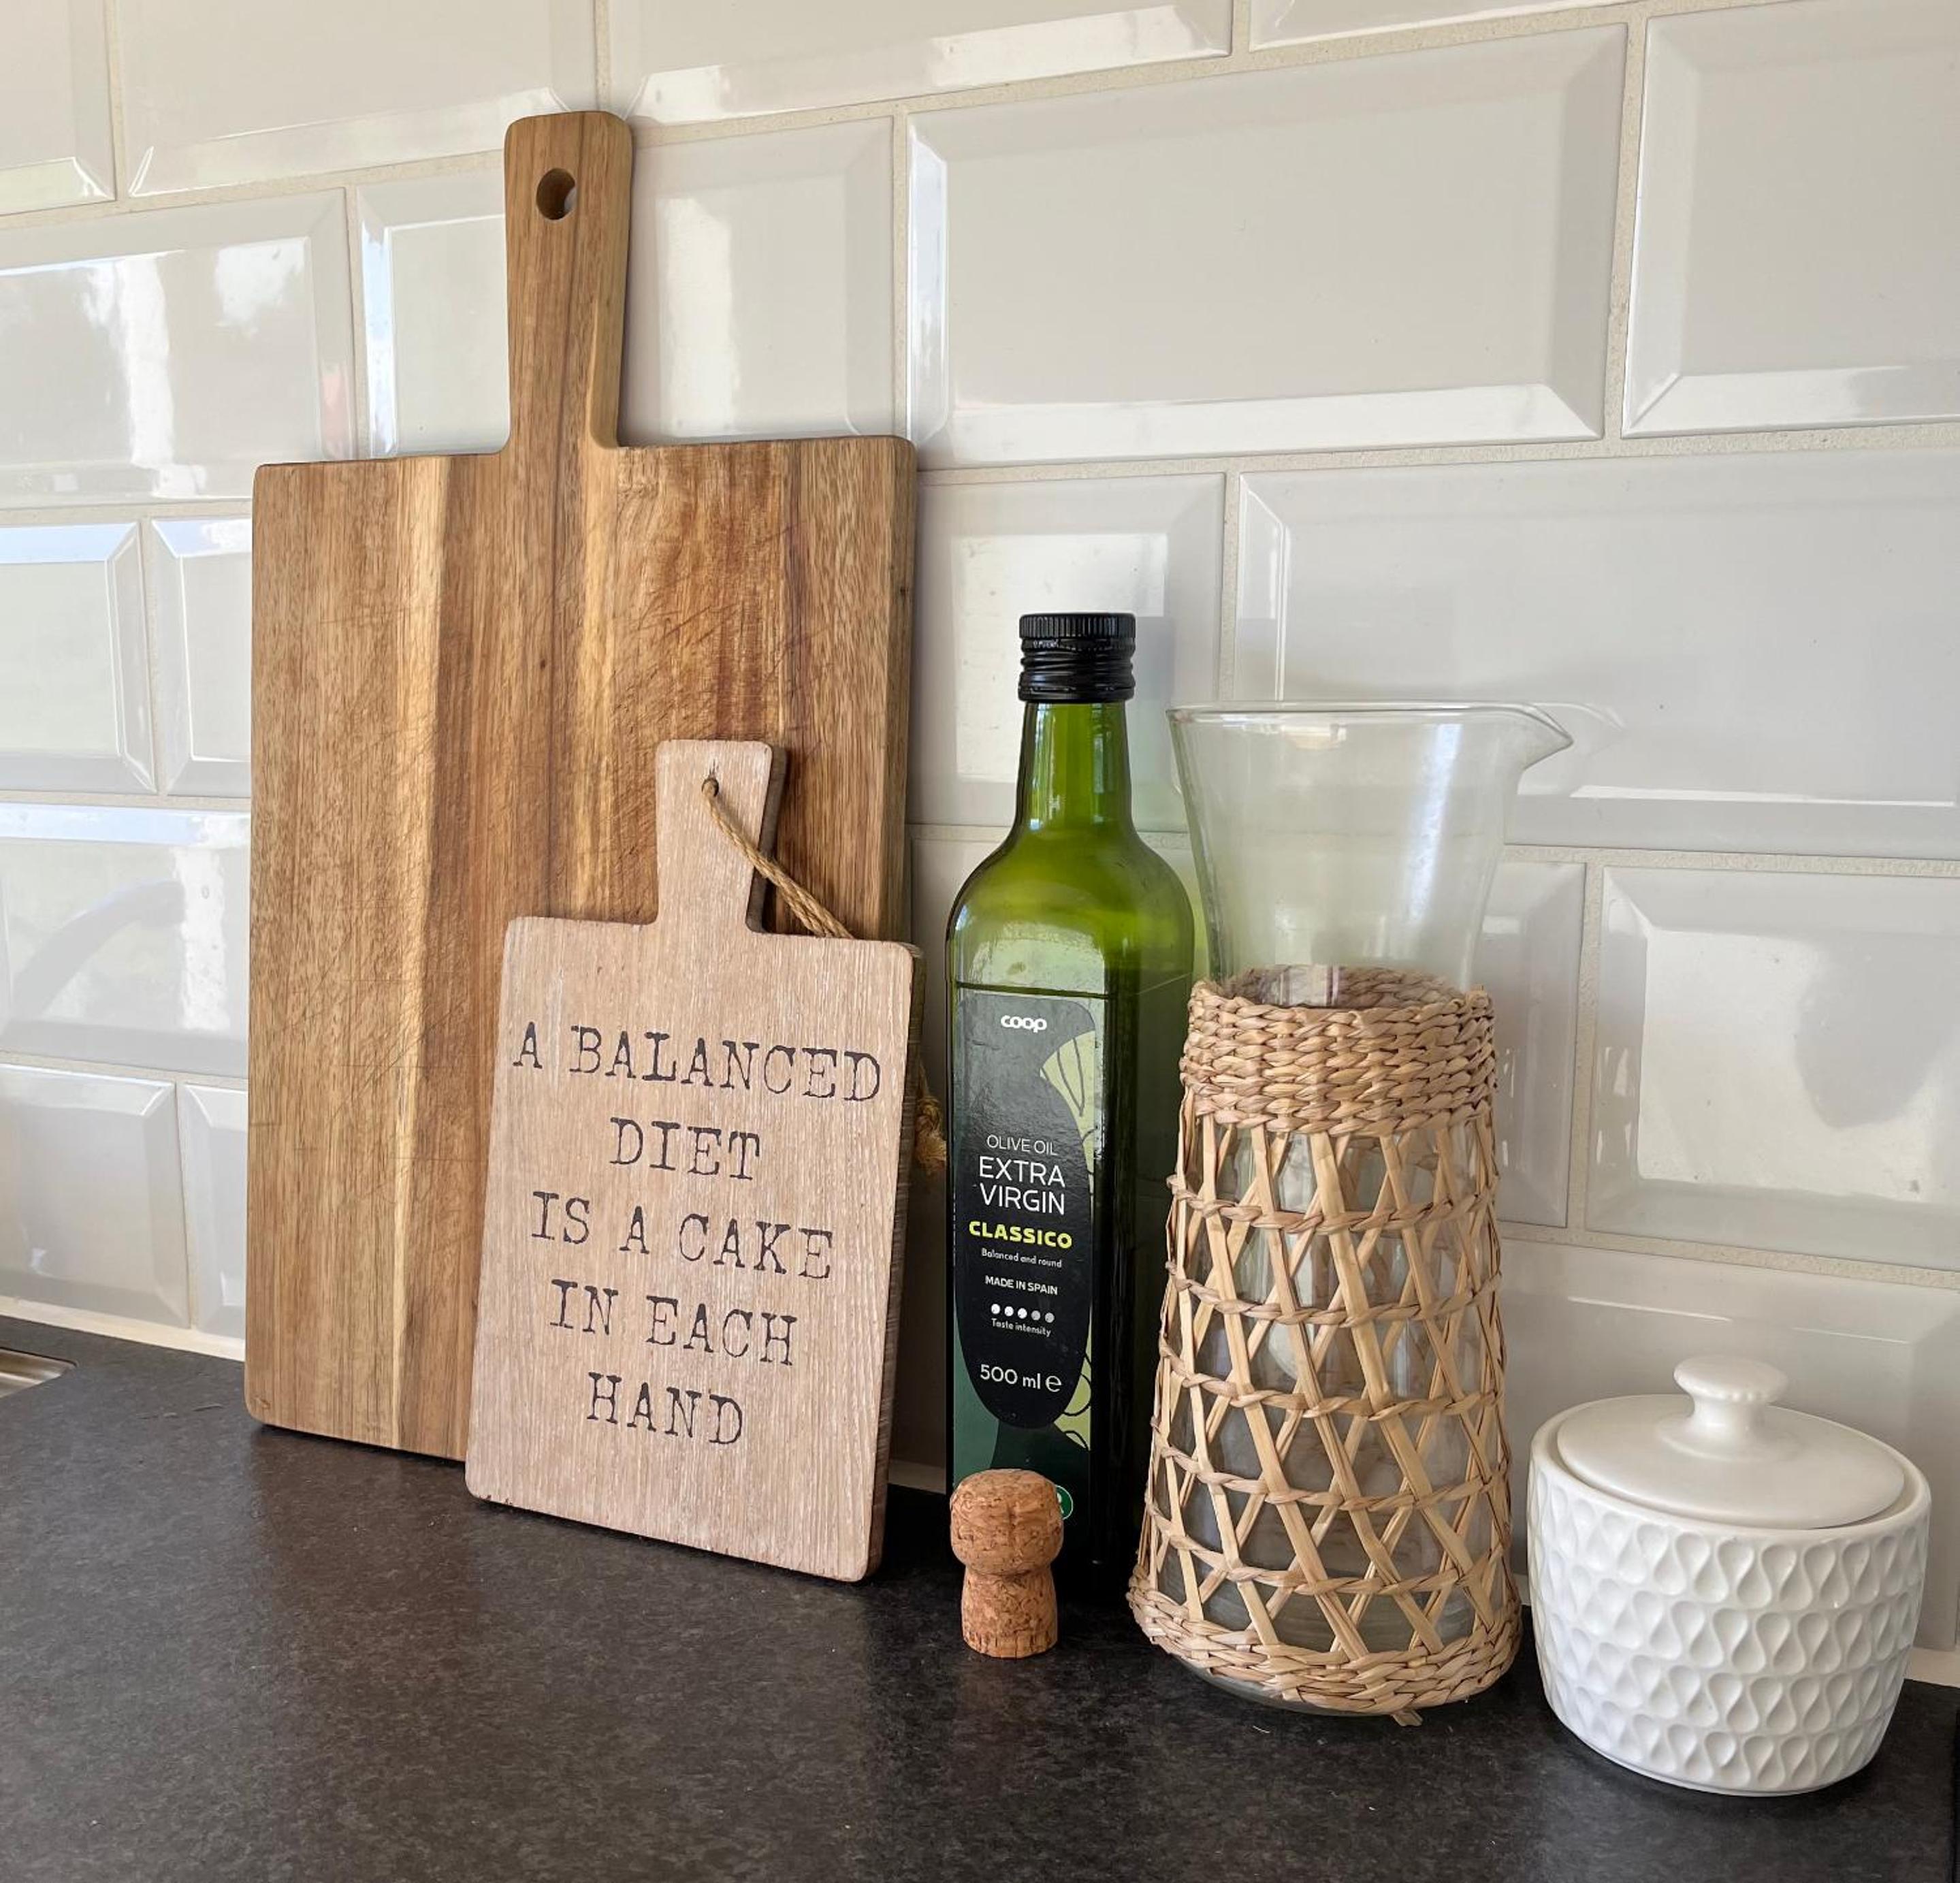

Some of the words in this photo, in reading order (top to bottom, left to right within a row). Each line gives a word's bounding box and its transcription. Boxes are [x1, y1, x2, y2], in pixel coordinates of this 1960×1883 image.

[1000, 1015, 1048, 1033] coop
[512, 1021, 543, 1069] A
[569, 1025, 881, 1101] BALANCED
[609, 1116, 760, 1180] DIET
[986, 1134, 1031, 1152] OLIVE
[1034, 1140, 1058, 1156] OIL
[979, 1156, 1066, 1187] EXTRA
[979, 1182, 1065, 1215] VIRGIN
[532, 1191, 590, 1244] IS
[619, 1205, 650, 1255] A
[678, 1213, 833, 1280] CAKE
[969, 1221, 1073, 1249] CLASSICO
[981, 1247, 1019, 1262] Balanced
[1020, 1254, 1037, 1265] and
[1038, 1257, 1062, 1268] round
[984, 1275, 1014, 1290] MADE
[1016, 1280, 1026, 1291] IN
[1027, 1281, 1058, 1295] SPAIN
[550, 1278, 619, 1336] IN
[645, 1295, 798, 1366] EACH
[991, 1318, 1014, 1330] Taste
[1015, 1321, 1051, 1337] intensity
[980, 1364, 1018, 1385] 500
[1023, 1372, 1041, 1389] ml
[587, 1371, 743, 1445] HAND
